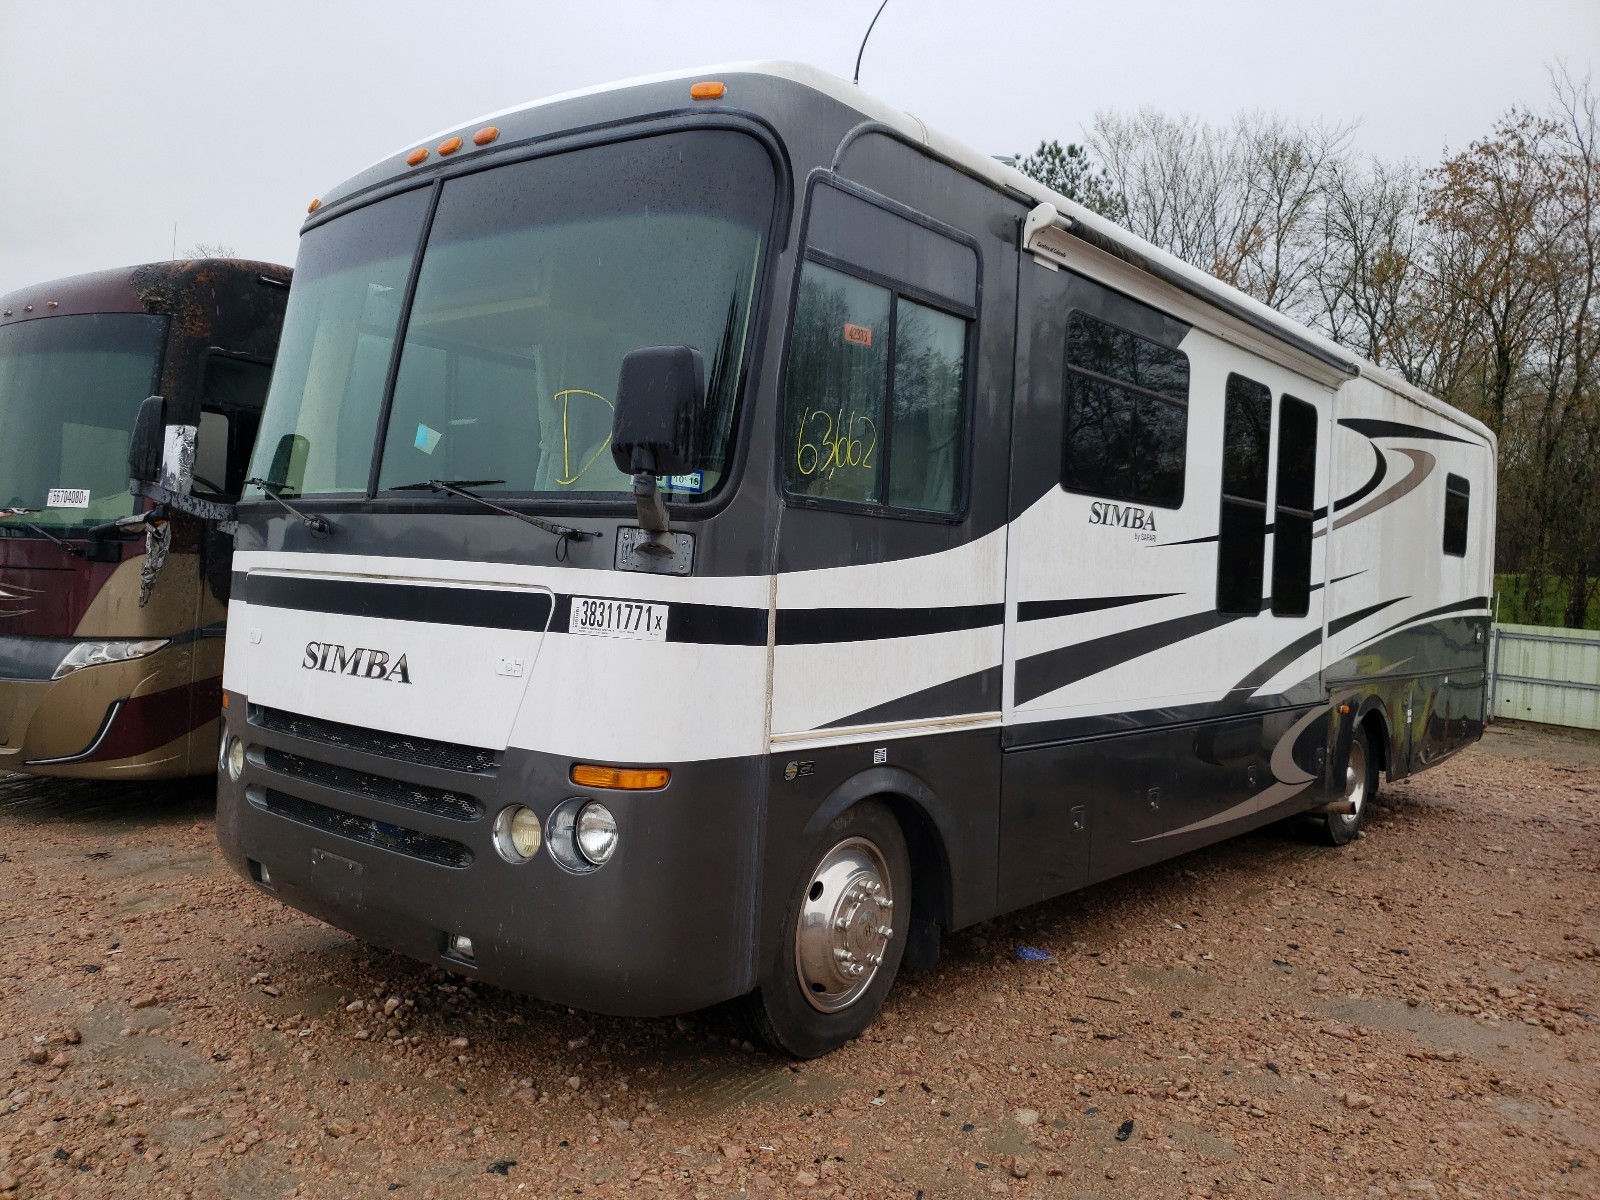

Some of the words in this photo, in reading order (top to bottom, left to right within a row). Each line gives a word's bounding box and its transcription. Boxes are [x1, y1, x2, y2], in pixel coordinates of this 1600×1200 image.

[1088, 501, 1157, 531] SIMBA
[1134, 532, 1141, 542] by
[580, 600, 652, 632] 38311771
[301, 640, 412, 685] SIMBA
